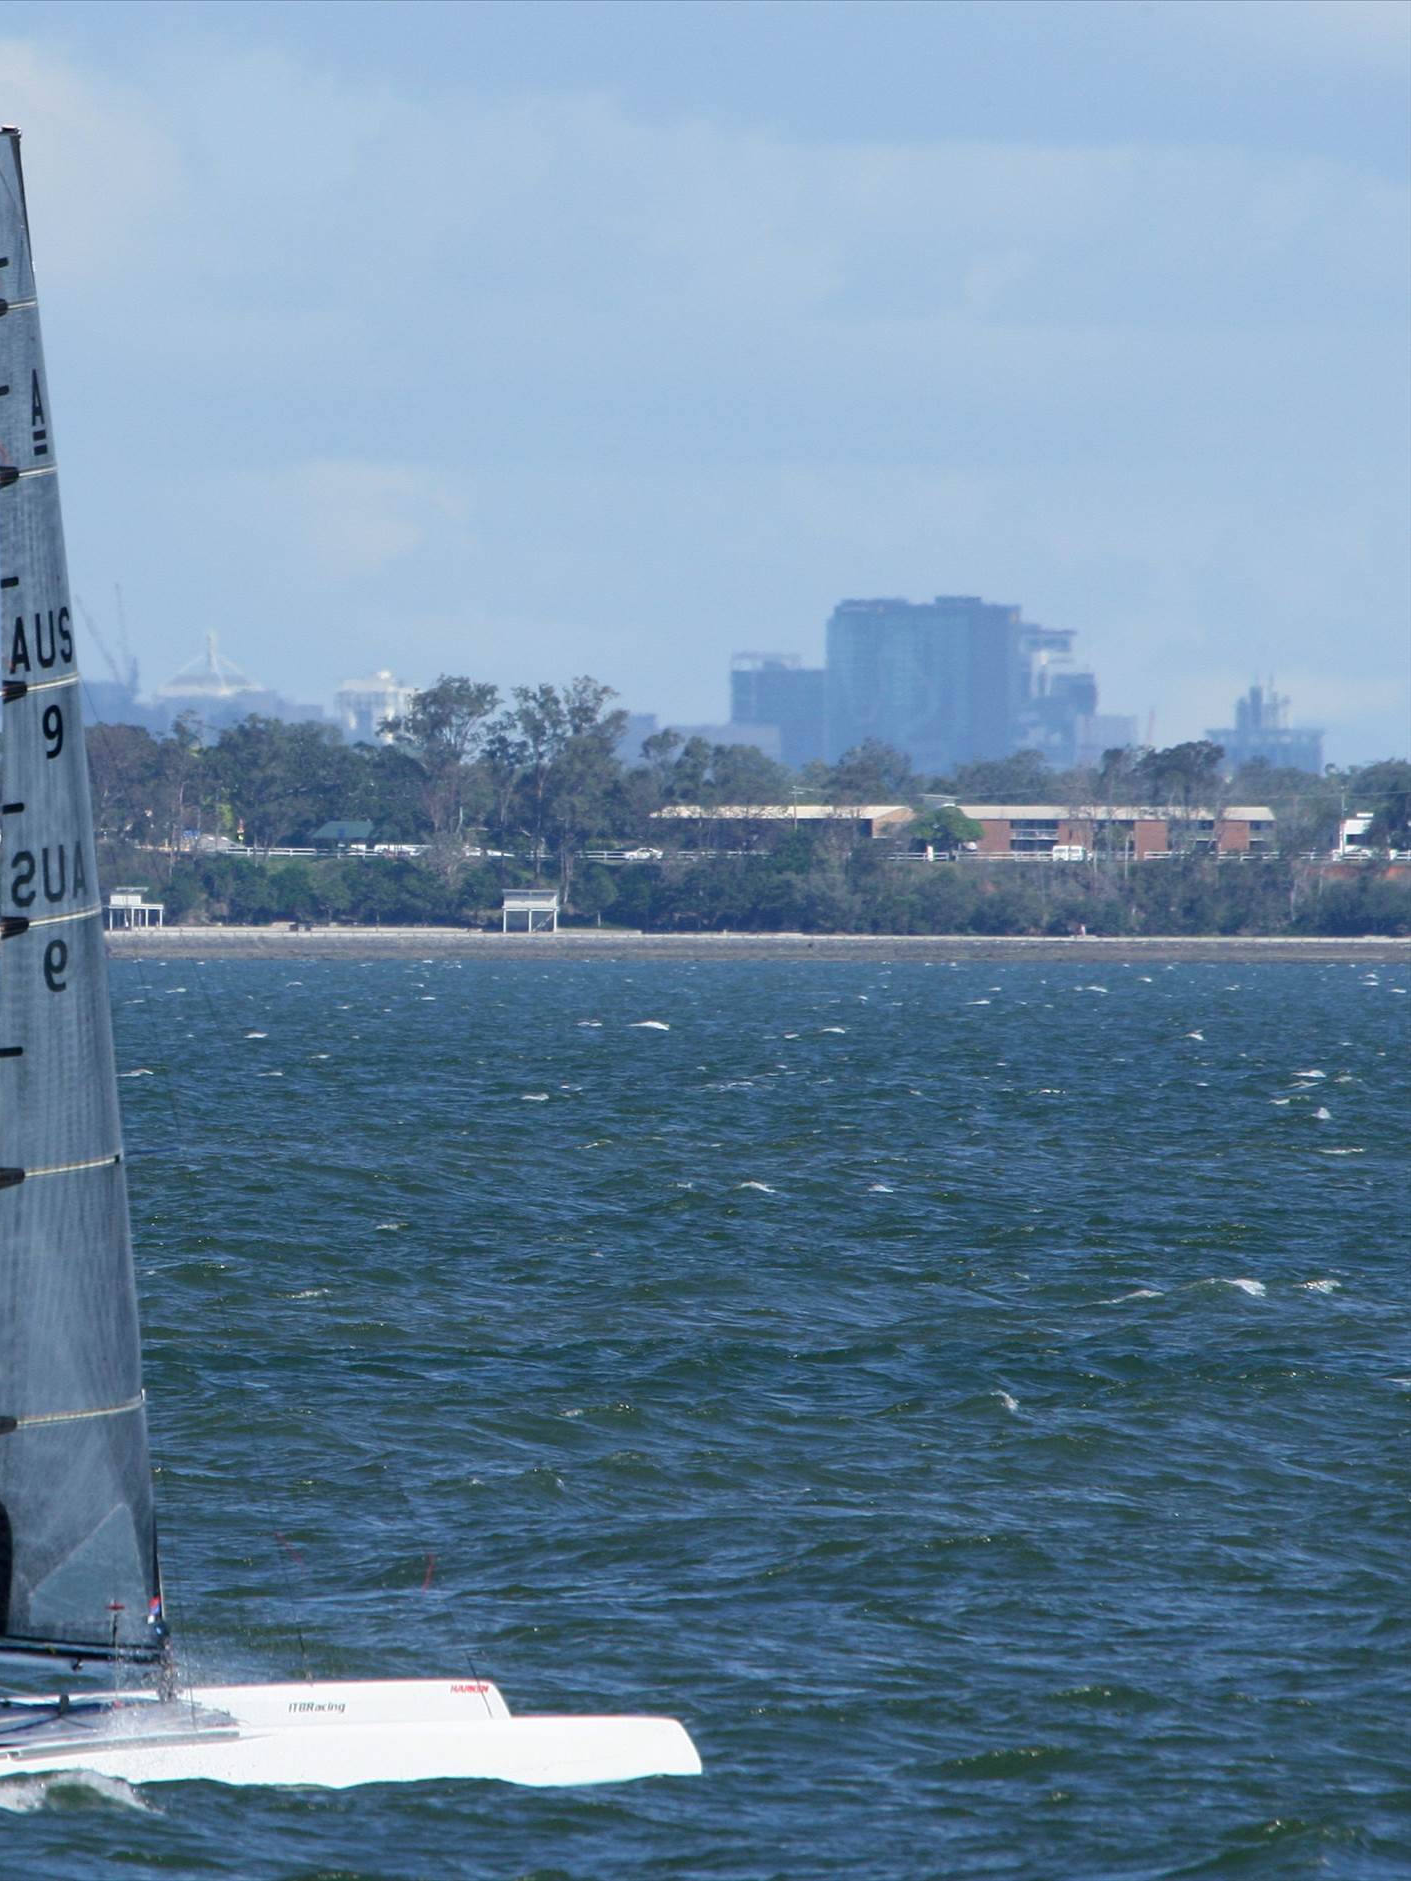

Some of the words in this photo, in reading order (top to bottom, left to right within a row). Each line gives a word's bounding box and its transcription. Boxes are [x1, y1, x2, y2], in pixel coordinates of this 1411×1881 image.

[31, 369, 45, 427] A
[10, 606, 73, 674] AUS
[42, 704, 64, 759] 9
